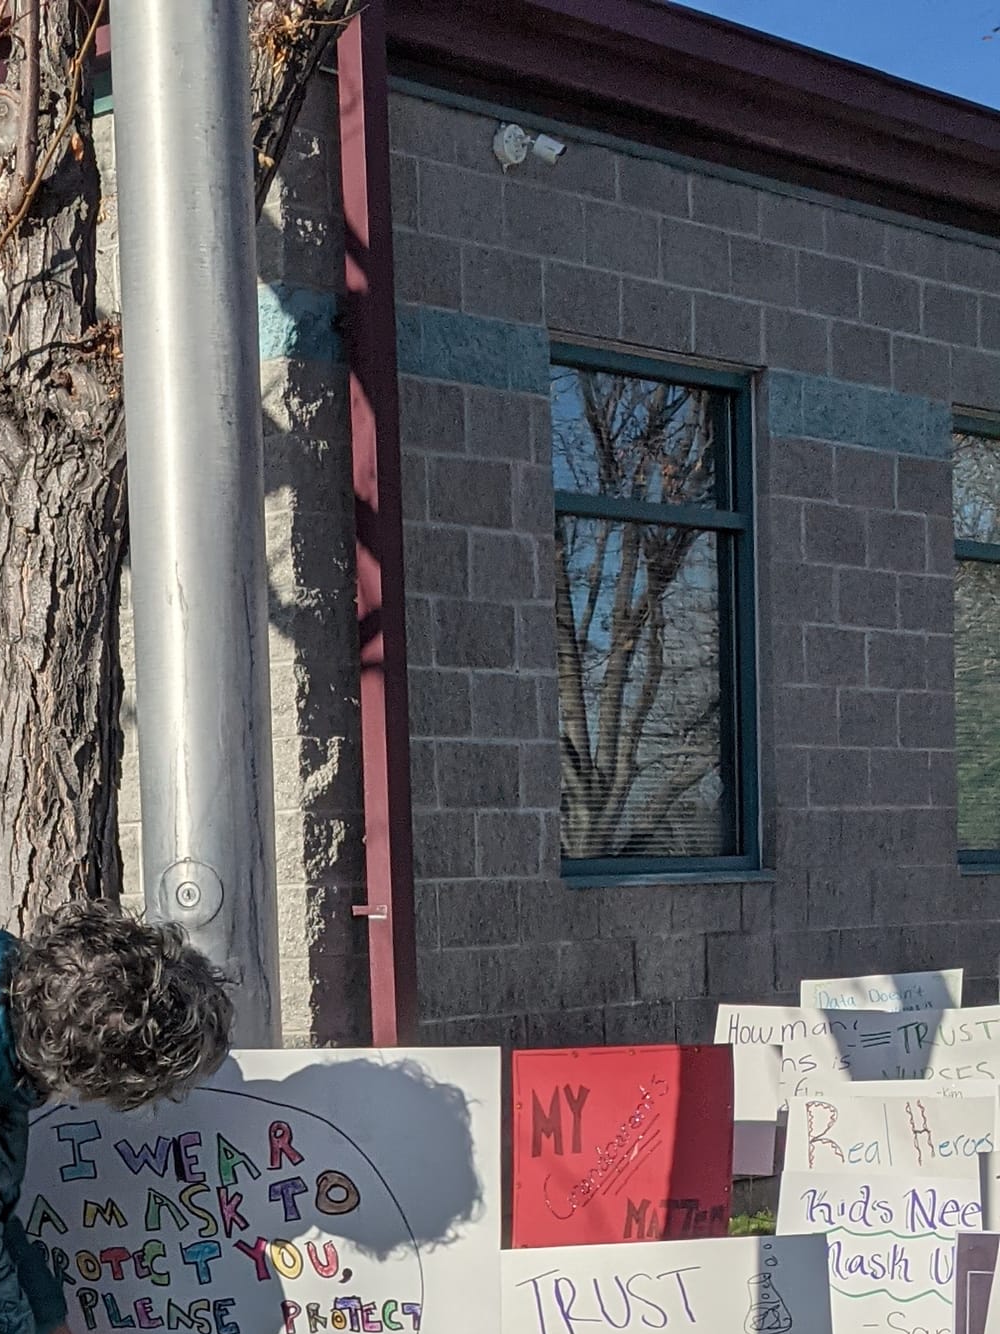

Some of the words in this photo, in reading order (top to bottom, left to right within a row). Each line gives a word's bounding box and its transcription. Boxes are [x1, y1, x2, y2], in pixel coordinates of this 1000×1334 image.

[817, 990, 856, 1009] Data
[728, 1013, 772, 1045] How
[897, 1018, 1000, 1053] TRUST
[531, 1083, 591, 1158] MY
[805, 1100, 893, 1169] Real
[51, 1119, 101, 1182] I
[115, 1119, 305, 1186] WEAR
[26, 1193, 67, 1237] A
[82, 1183, 250, 1238] MASK
[269, 1169, 361, 1222] TO
[902, 1187, 982, 1232] Nee
[233, 1237, 354, 1284] YOU,
[930, 1245, 956, 1285] U
